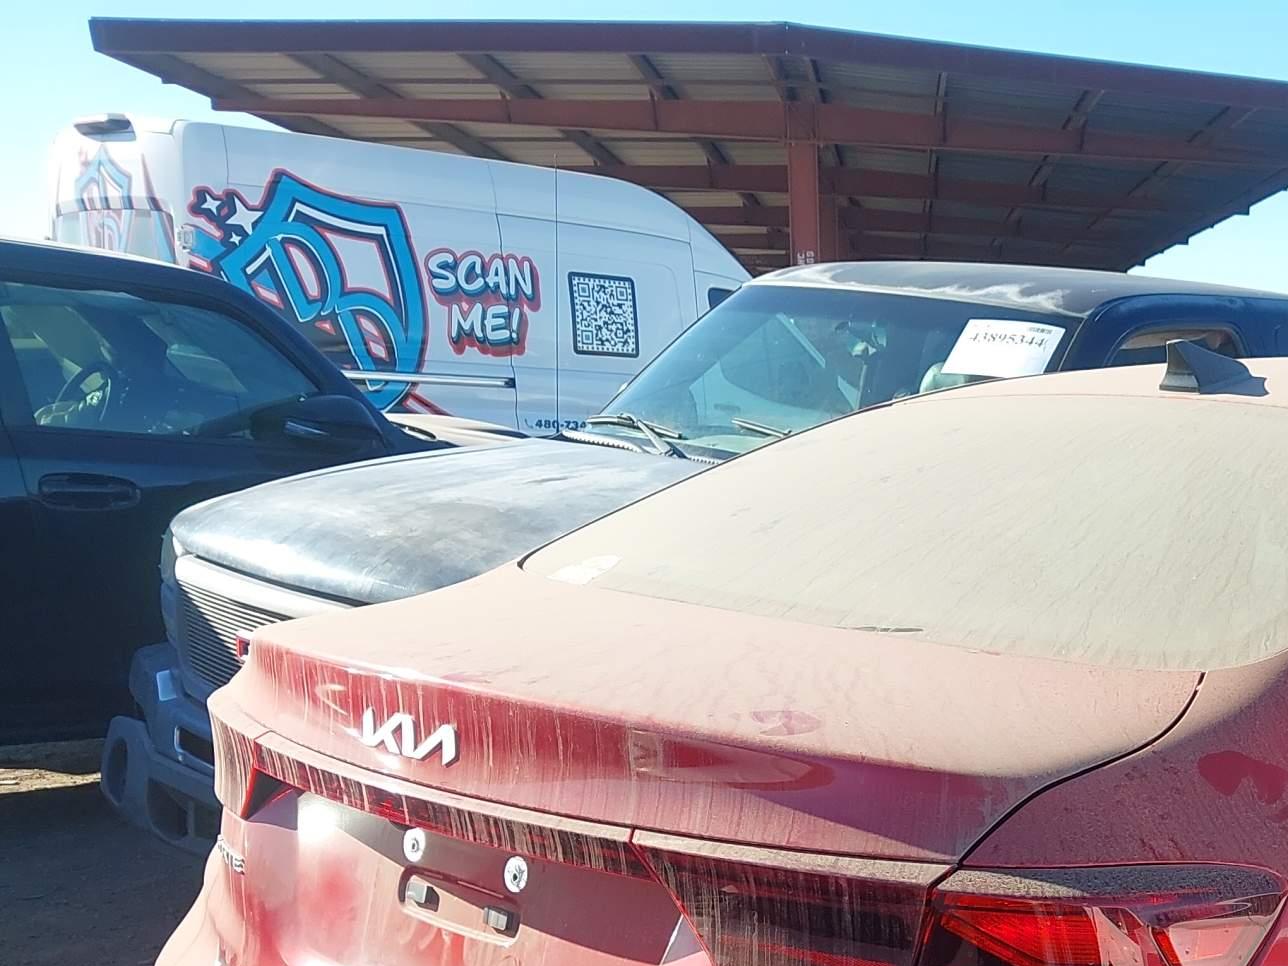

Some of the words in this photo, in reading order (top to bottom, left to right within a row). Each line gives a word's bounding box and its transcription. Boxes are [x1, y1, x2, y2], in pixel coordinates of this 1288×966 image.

[427, 251, 535, 299] SCAN
[451, 302, 521, 345] ME!
[361, 706, 460, 769] KIA
